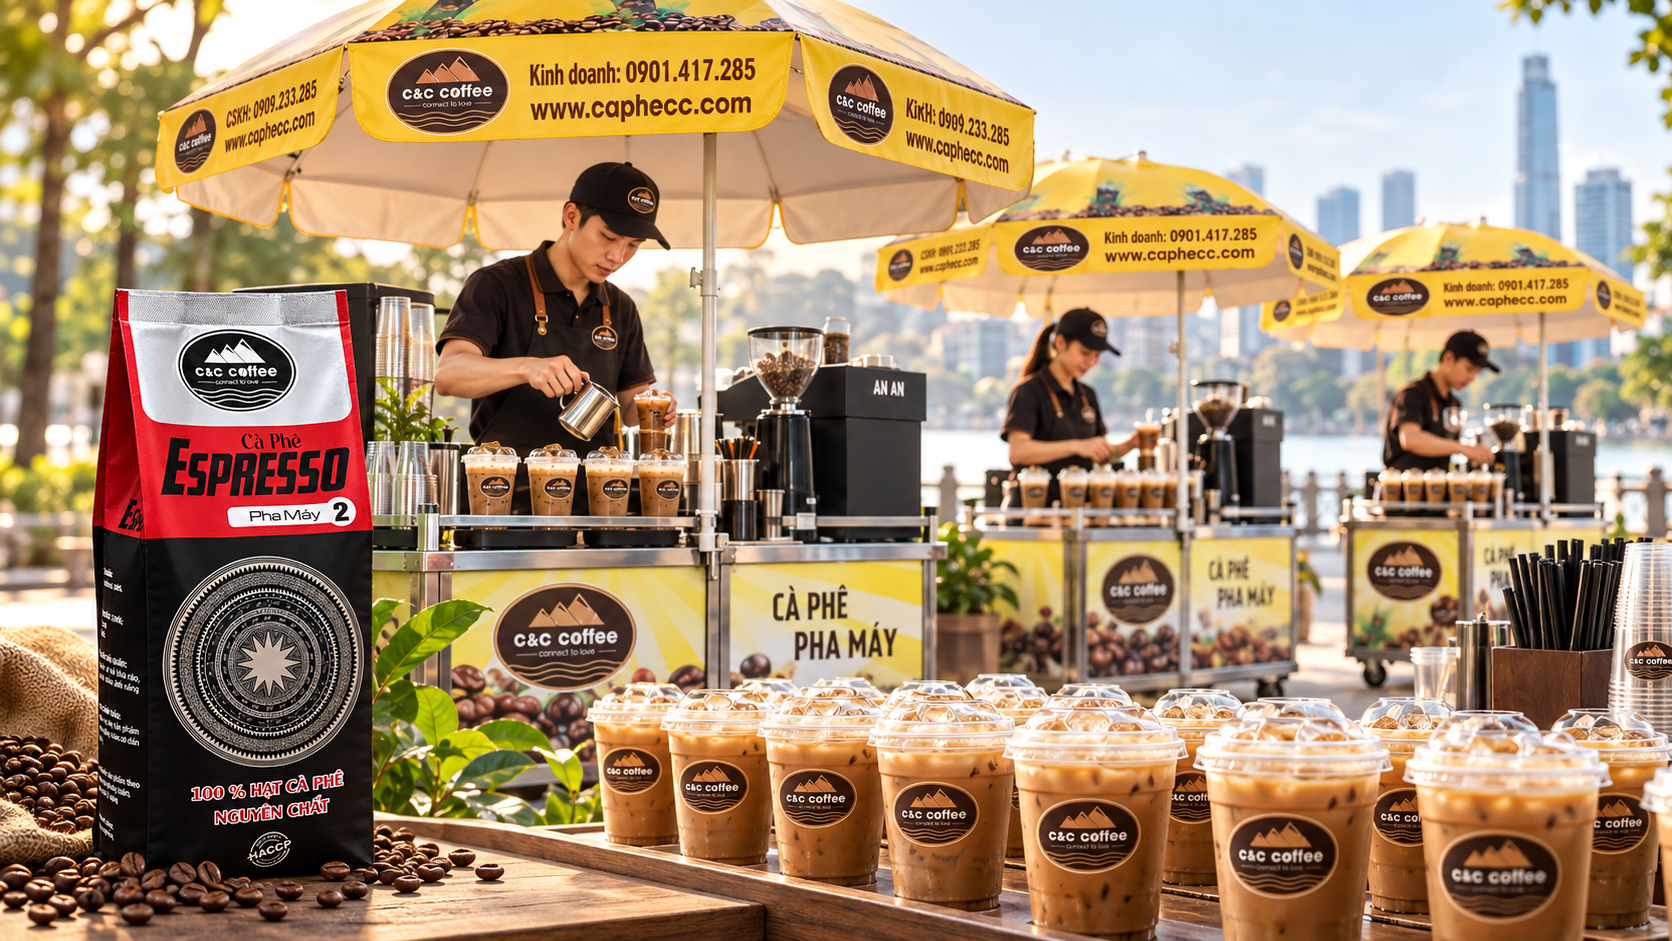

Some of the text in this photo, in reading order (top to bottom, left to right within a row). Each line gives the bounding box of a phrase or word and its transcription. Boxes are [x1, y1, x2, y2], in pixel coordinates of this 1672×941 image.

[529, 57, 756, 86] Kinh doanh: 0901.417.285
[439, 83, 493, 99] coffee
[226, 79, 317, 128] CSKH: 0909.233.285
[530, 94, 751, 123] www.caphecc.com
[856, 101, 887, 119] coffee
[225, 111, 315, 153] www.caphecc.com
[906, 131, 1009, 174] www.caphecc.com
[1105, 228, 1257, 244] Kinh doanh: 0901.417.285
[1046, 243, 1081, 253] coffee
[1105, 247, 1255, 263] www.caphecc.com
[1443, 278, 1569, 293] Kinh doanh: 0901.417.285
[1444, 294, 1567, 308] www.caphecc.com
[228, 365, 278, 377] coffee
[873, 379, 905, 397] AN AN
[241, 432, 302, 450] Cà Phê
[250, 502, 350, 525] Pha Máy 2
[1397, 565, 1433, 578] coffee
[773, 584, 848, 621] CÀ PHÊ
[558, 628, 618, 645] coffee
[794, 621, 898, 661] PHA MÁY
[623, 767, 653, 776] coffee
[191, 768, 344, 801] 100 % HẠT CÀ PHÊ
[705, 783, 739, 792] coffee
[808, 793, 846, 804] coffee
[214, 794, 330, 826] NGUYÊN CHẤT
[926, 808, 967, 820] coffee
[1605, 817, 1642, 829] coffee
[1080, 829, 1128, 842] coffee
[247, 839, 292, 861] HACCP
[1271, 849, 1324, 863] coffee
[1488, 868, 1547, 885] coffee
